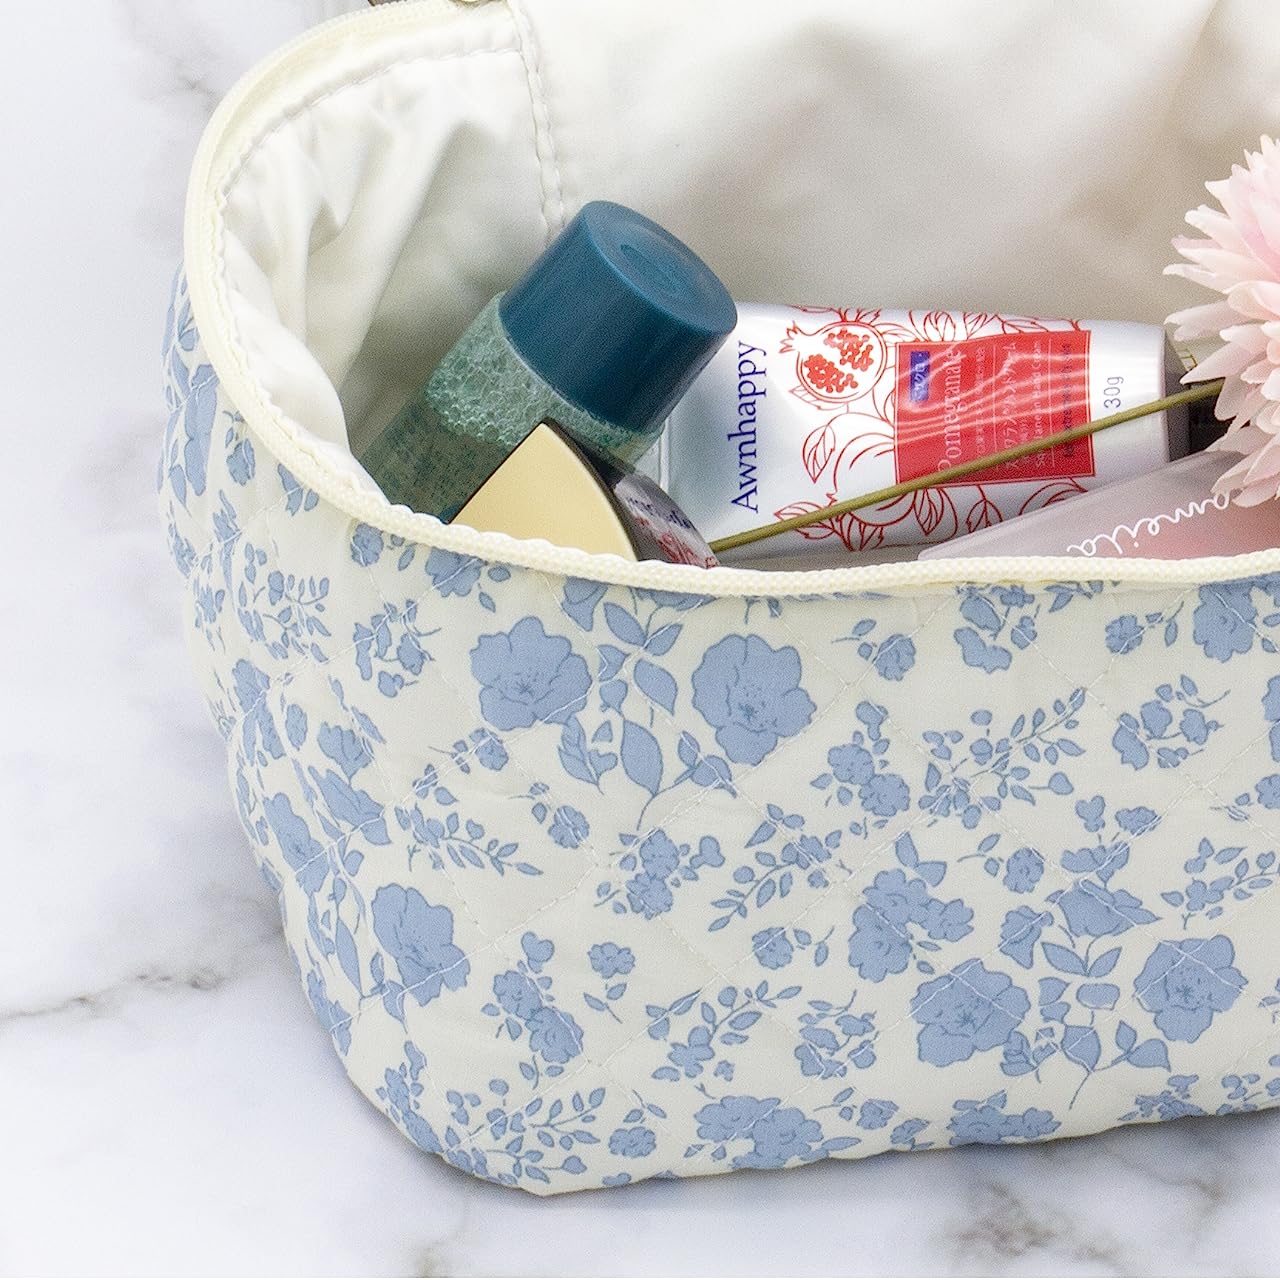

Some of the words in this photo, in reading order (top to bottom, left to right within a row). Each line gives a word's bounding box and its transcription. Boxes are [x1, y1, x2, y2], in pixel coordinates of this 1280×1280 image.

[727, 340, 767, 514] Awnhappy
[938, 350, 968, 473] Pomegranate
[1103, 376, 1124, 409] 30g
